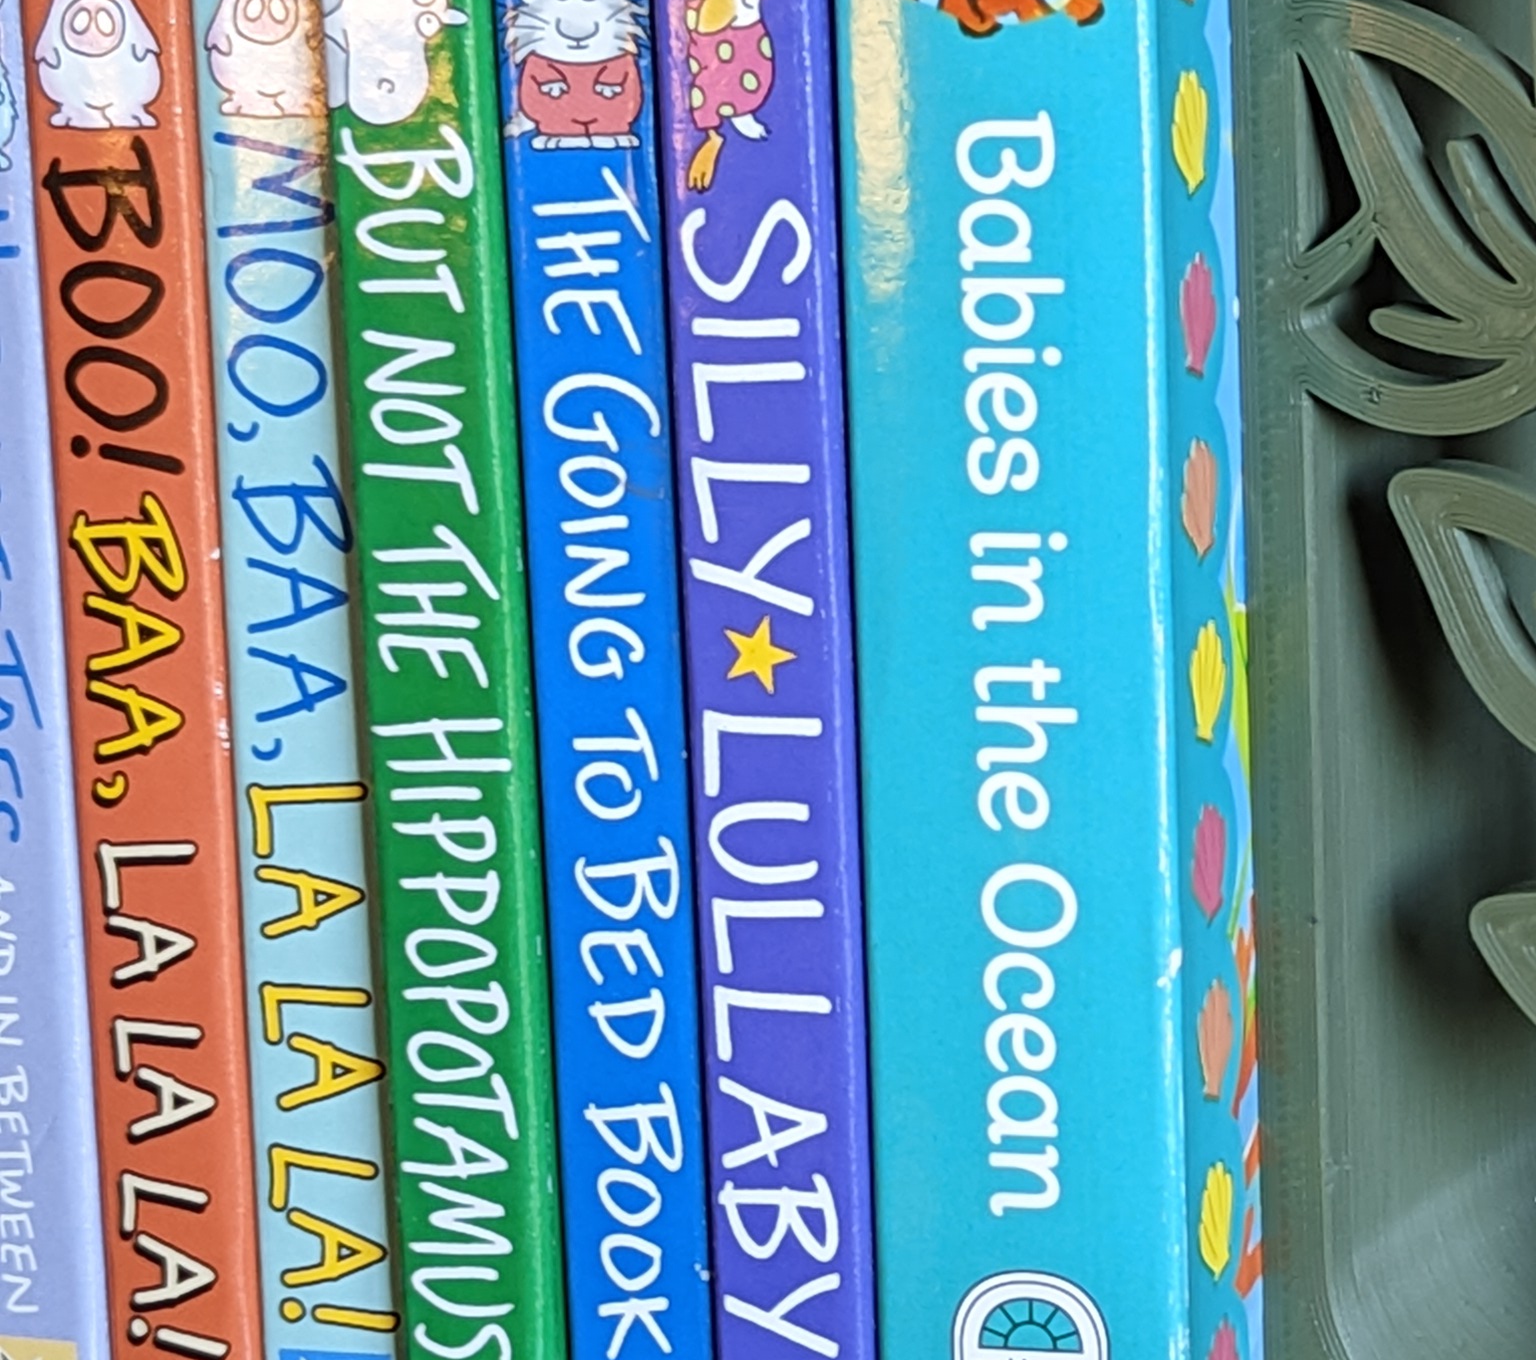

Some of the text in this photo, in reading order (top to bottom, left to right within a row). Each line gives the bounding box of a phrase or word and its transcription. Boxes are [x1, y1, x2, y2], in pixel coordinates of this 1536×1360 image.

[42, 136, 186, 476] BOO!
[335, 124, 475, 314] BUT
[532, 166, 652, 356] THE
[361, 329, 480, 516] NOT
[542, 371, 663, 681] GOING
[70, 490, 189, 808] BAA,
[371, 524, 501, 689] THE
[955, 110, 1079, 1217] Babies in the Ocean
[213, 131, 401, 1333] MOO, BAA, LA LA LA!
[572, 706, 660, 823] TO
[680, 197, 840, 1360] SILLY LULLABY
[96, 841, 199, 988] LA
[574, 835, 681, 1060] BED
[0, 1065, 39, 1313] BETWEEN
[112, 1016, 218, 1142] LA
